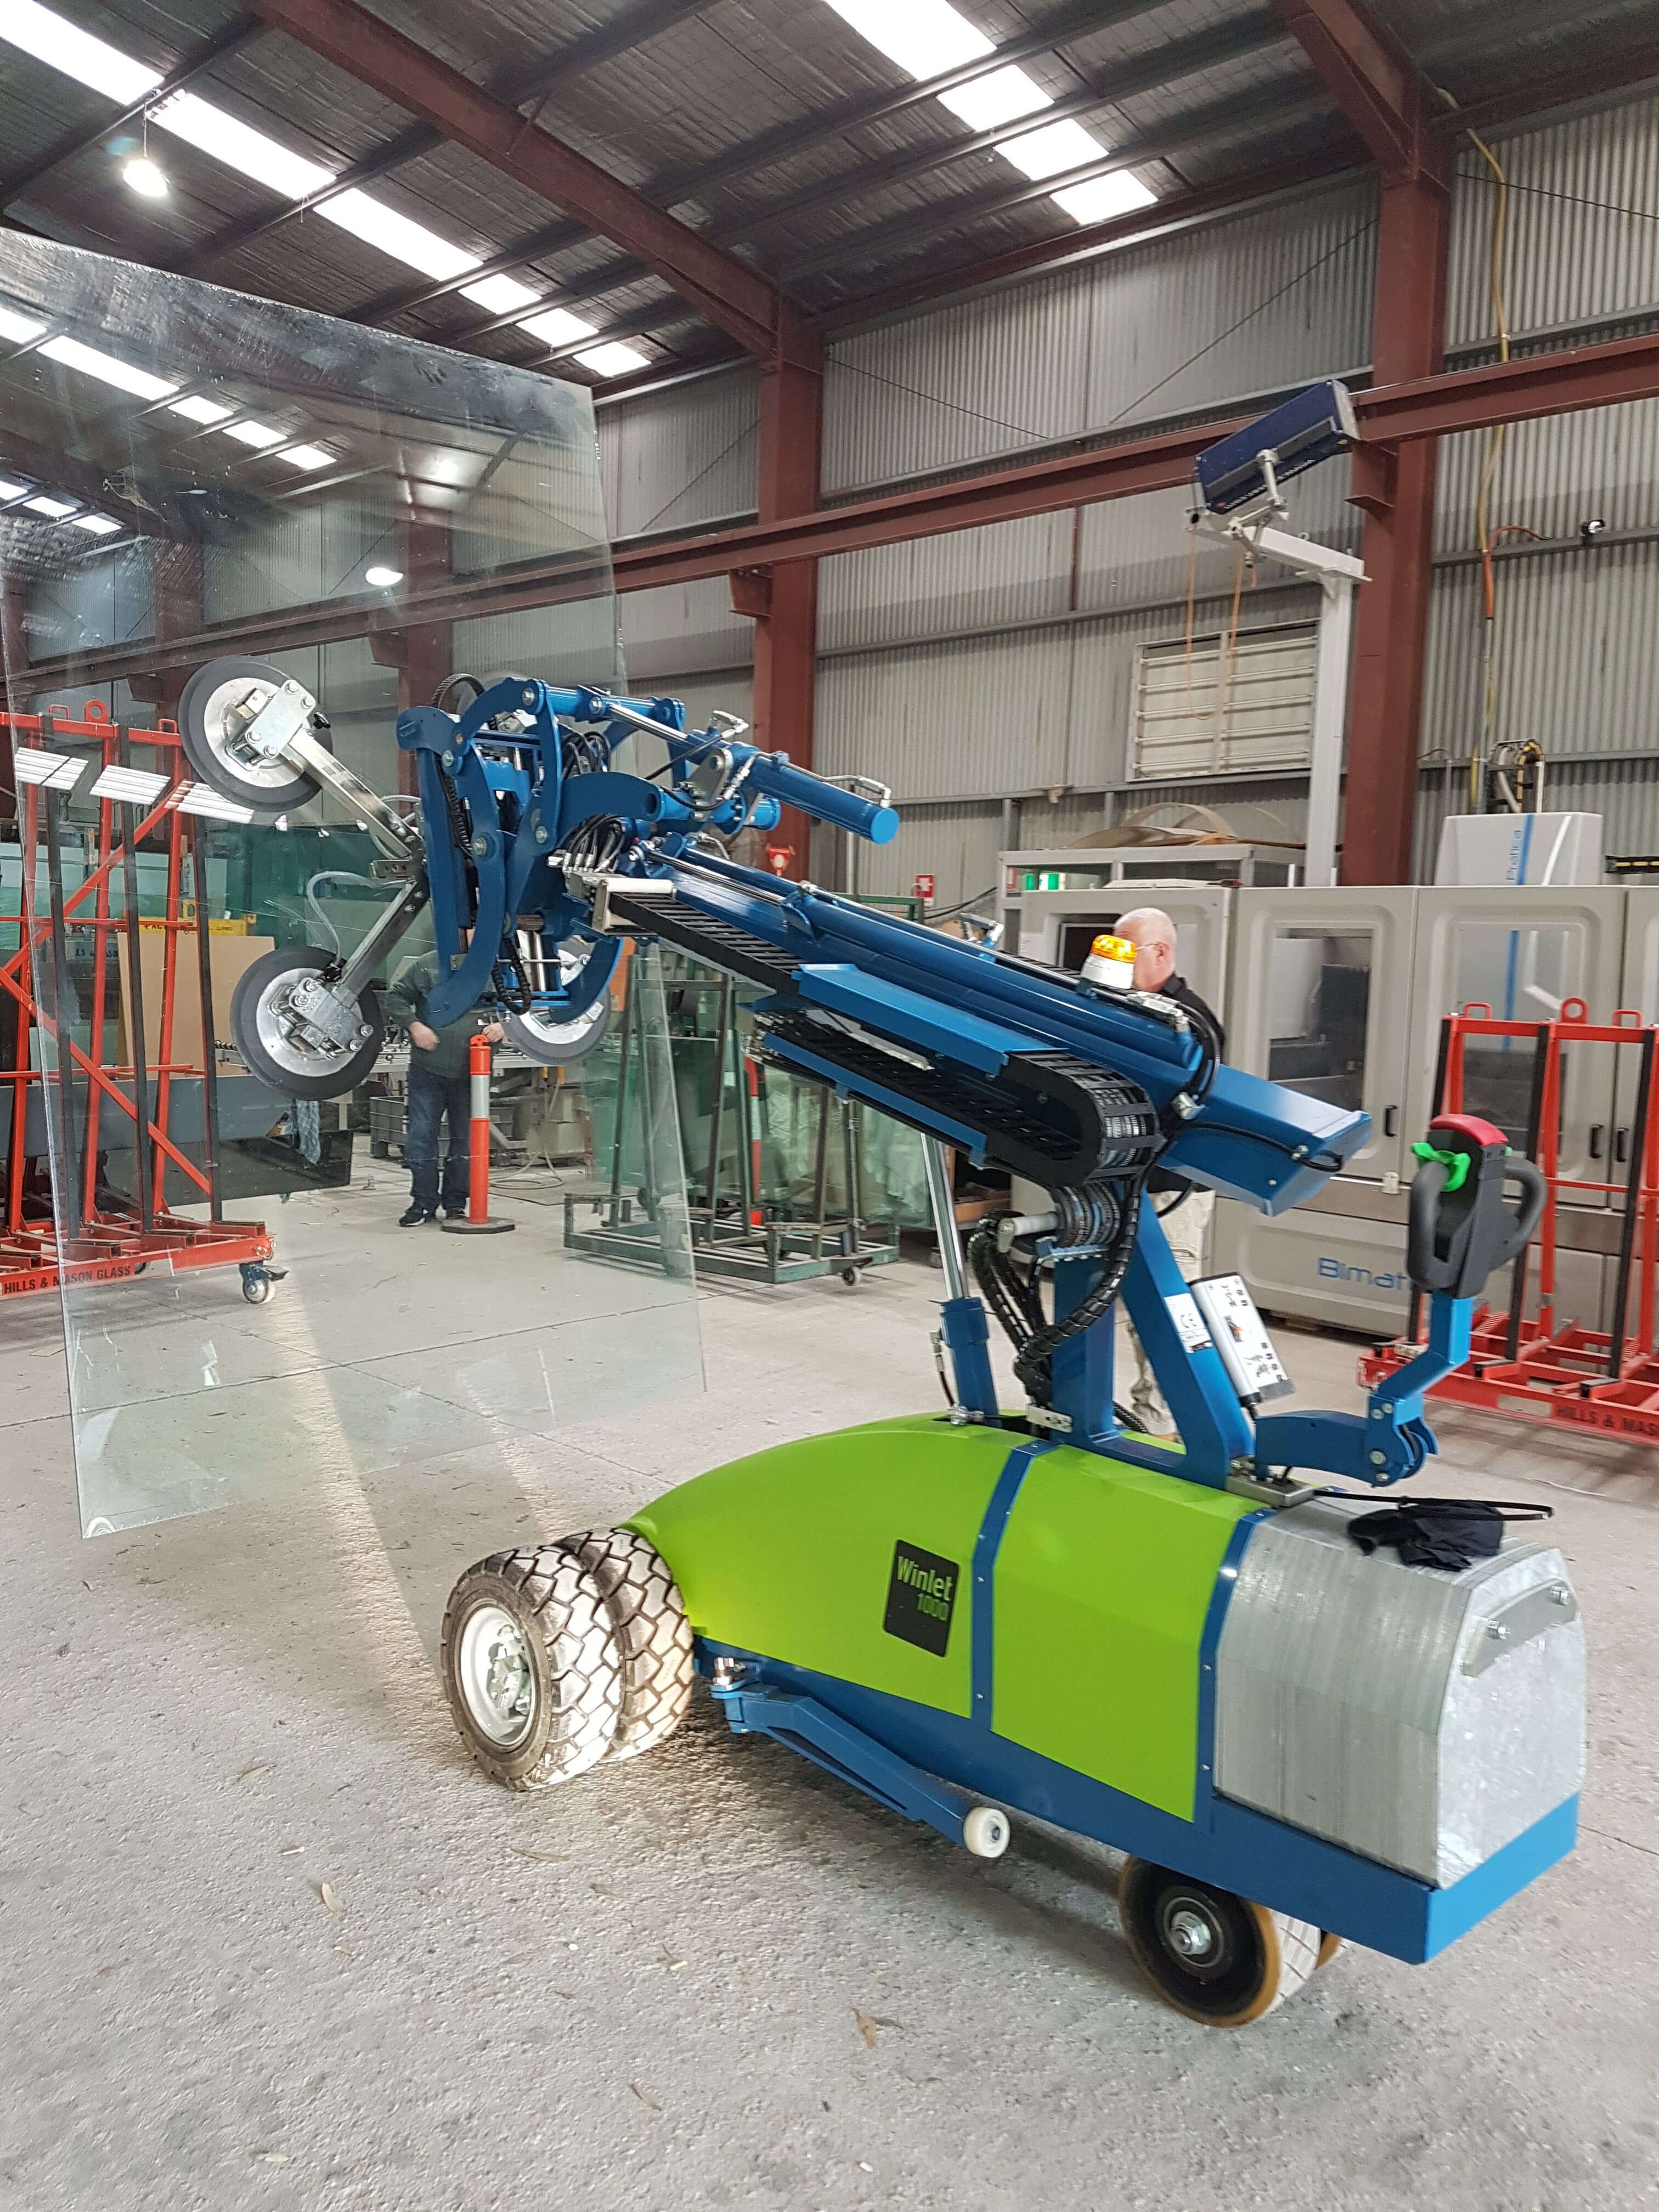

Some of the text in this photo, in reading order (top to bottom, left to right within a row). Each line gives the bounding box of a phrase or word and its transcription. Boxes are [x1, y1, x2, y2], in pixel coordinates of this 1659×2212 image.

[4, 1266, 131, 1294] HILLS & MASON GLASS
[1318, 1256, 1414, 1290] Bimat
[897, 1555, 952, 1601] Winlet
[917, 1593, 949, 1621] 1000
